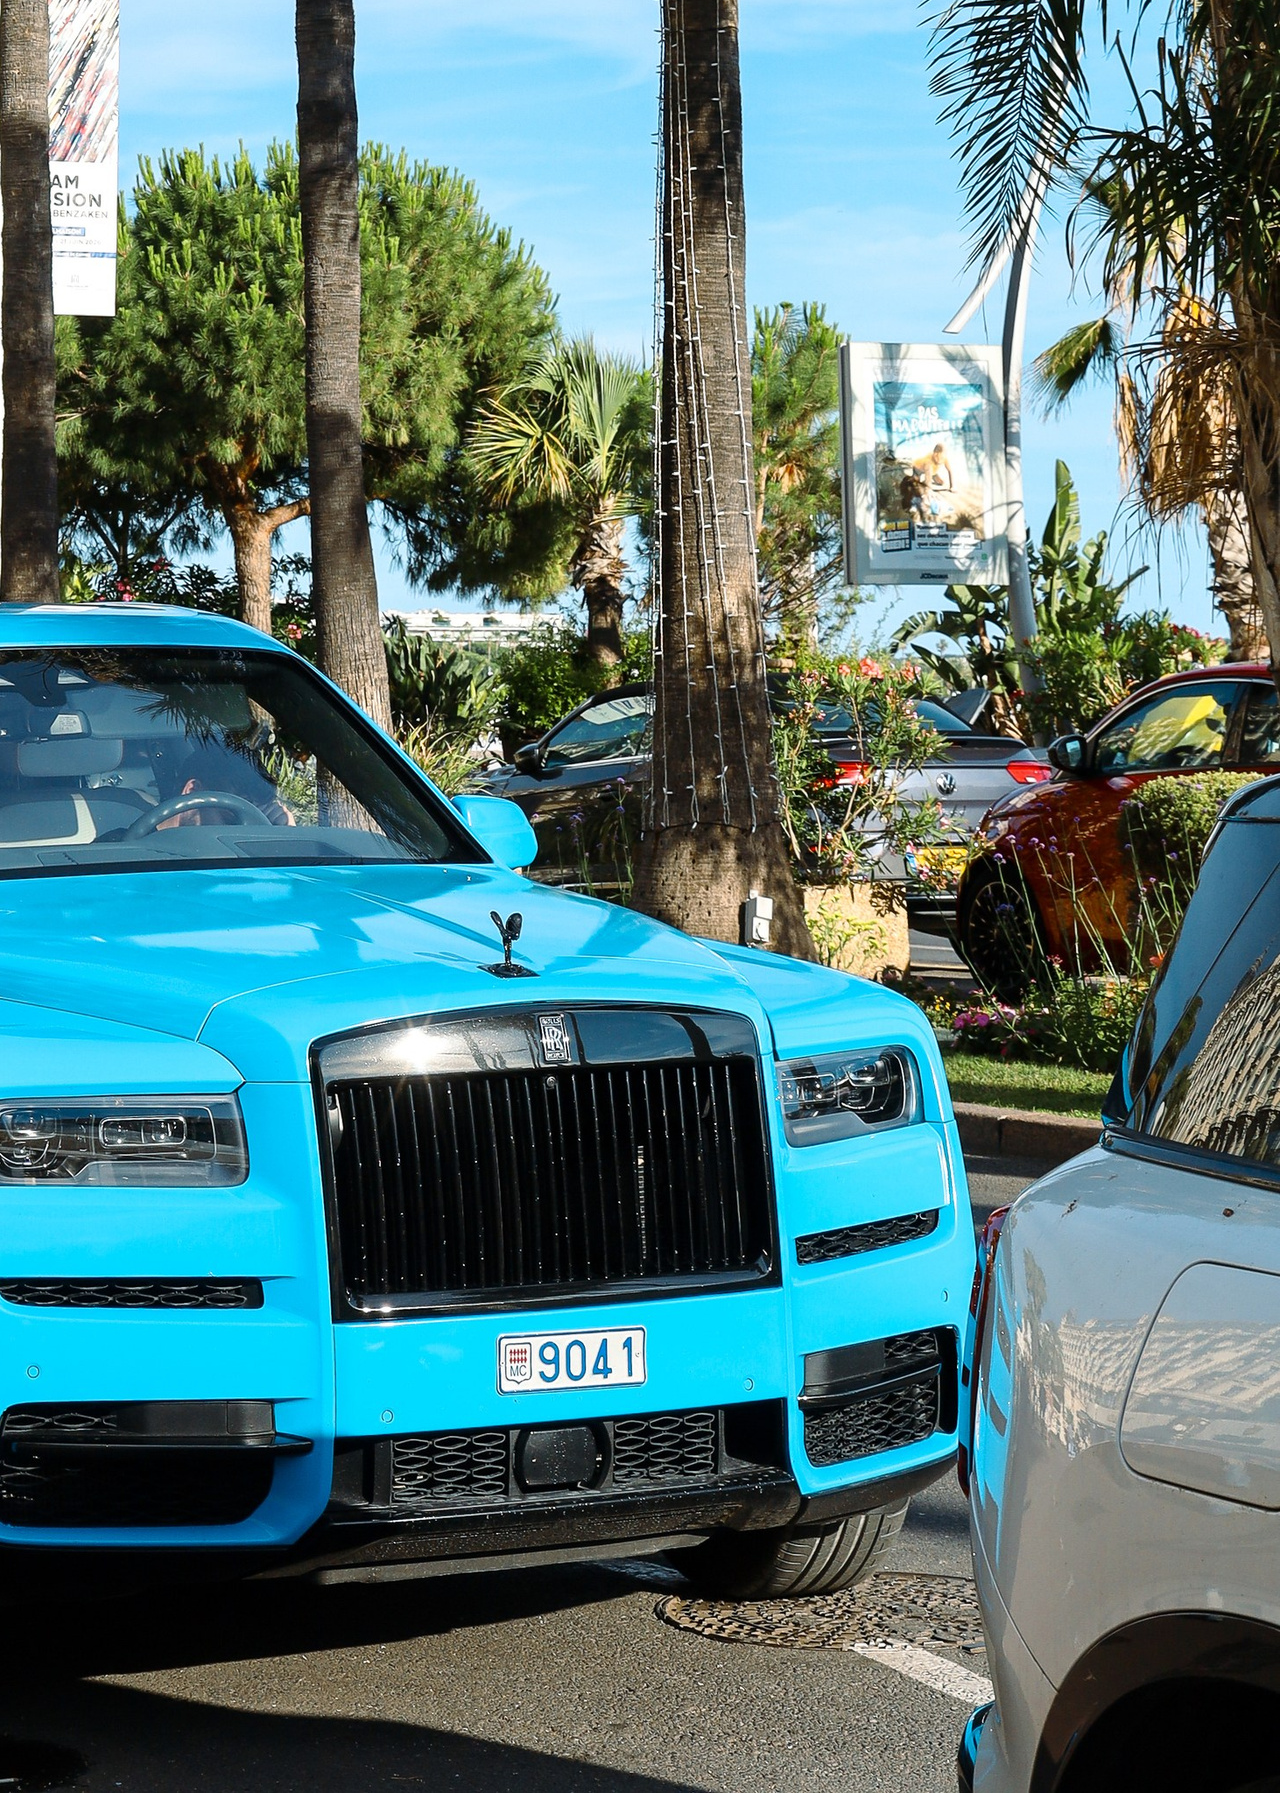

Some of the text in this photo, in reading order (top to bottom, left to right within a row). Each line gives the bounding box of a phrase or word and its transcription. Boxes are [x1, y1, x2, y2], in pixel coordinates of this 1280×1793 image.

[50, 174, 79, 189] AM
[53, 192, 101, 207] SION
[53, 209, 108, 218] BENZAKEN
[510, 1336, 633, 1383] MC 9041
